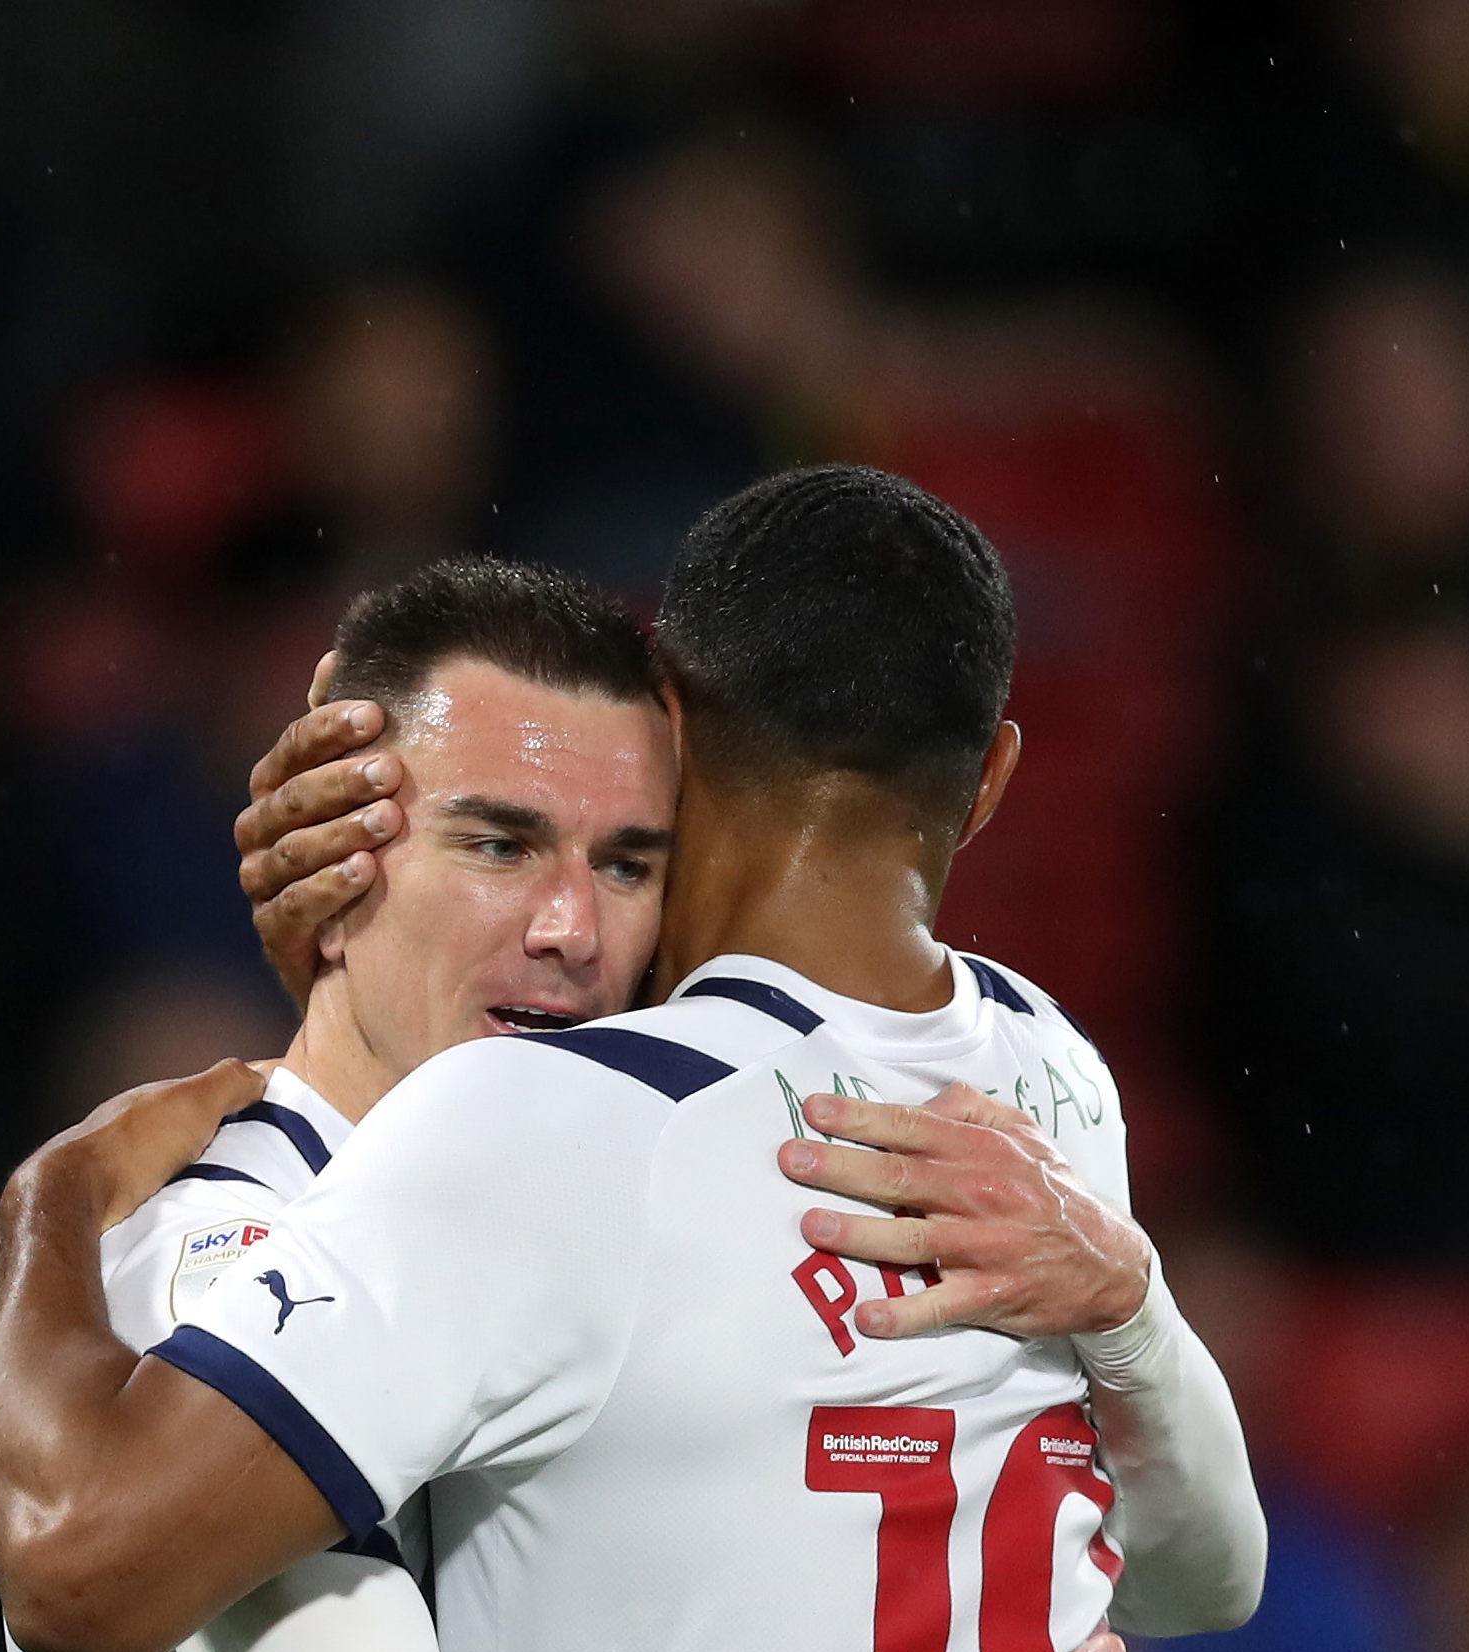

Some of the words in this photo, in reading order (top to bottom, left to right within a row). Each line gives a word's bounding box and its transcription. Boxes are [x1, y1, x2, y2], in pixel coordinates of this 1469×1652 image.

[185, 1249, 249, 1268] CHAMPI
[830, 1453, 865, 1463] OFFICIAL
[866, 1454, 898, 1464] CHARITY
[900, 1454, 931, 1464] PARTNER
